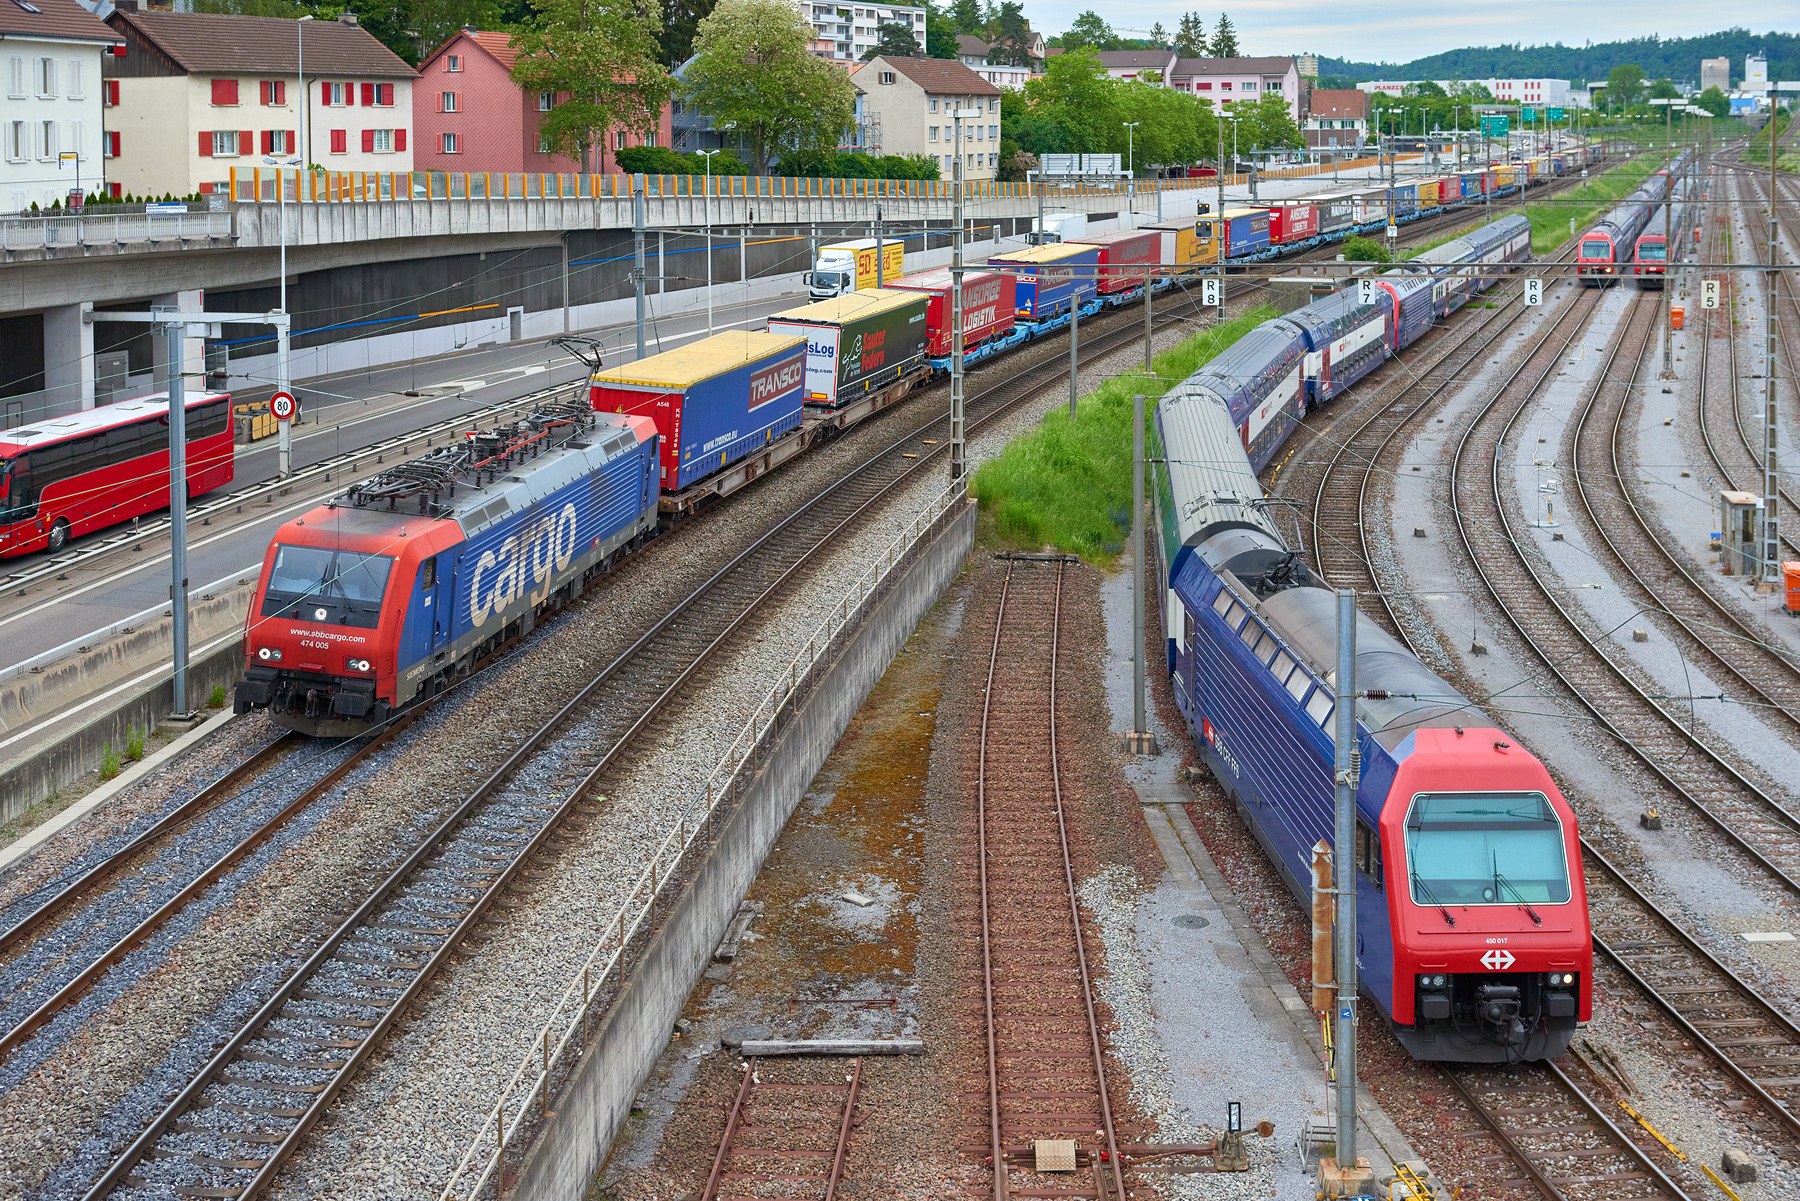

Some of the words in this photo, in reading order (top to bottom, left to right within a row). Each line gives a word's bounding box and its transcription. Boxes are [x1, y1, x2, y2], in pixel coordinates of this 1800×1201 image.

[1207, 280, 1215, 291] R
[1363, 280, 1371, 290] R
[1529, 280, 1538, 291] R
[1706, 282, 1715, 293] R
[1207, 294, 1215, 304] 8
[1363, 293, 1370, 303] 7
[1529, 294, 1538, 304] 6
[1706, 296, 1715, 308] 5
[963, 305, 996, 332] LOGISTIK
[862, 329, 886, 352] Sauter
[861, 349, 885, 372] Federn
[751, 361, 802, 401] TRANSCO
[277, 401, 288, 411] 80
[703, 429, 738, 453] www.transco.eu
[470, 503, 576, 628] cargo
[290, 628, 366, 643] www.sbbcargo.com
[300, 640, 314, 648] 474
[315, 641, 329, 650] 005
[406, 663, 426, 681] SIEMENS
